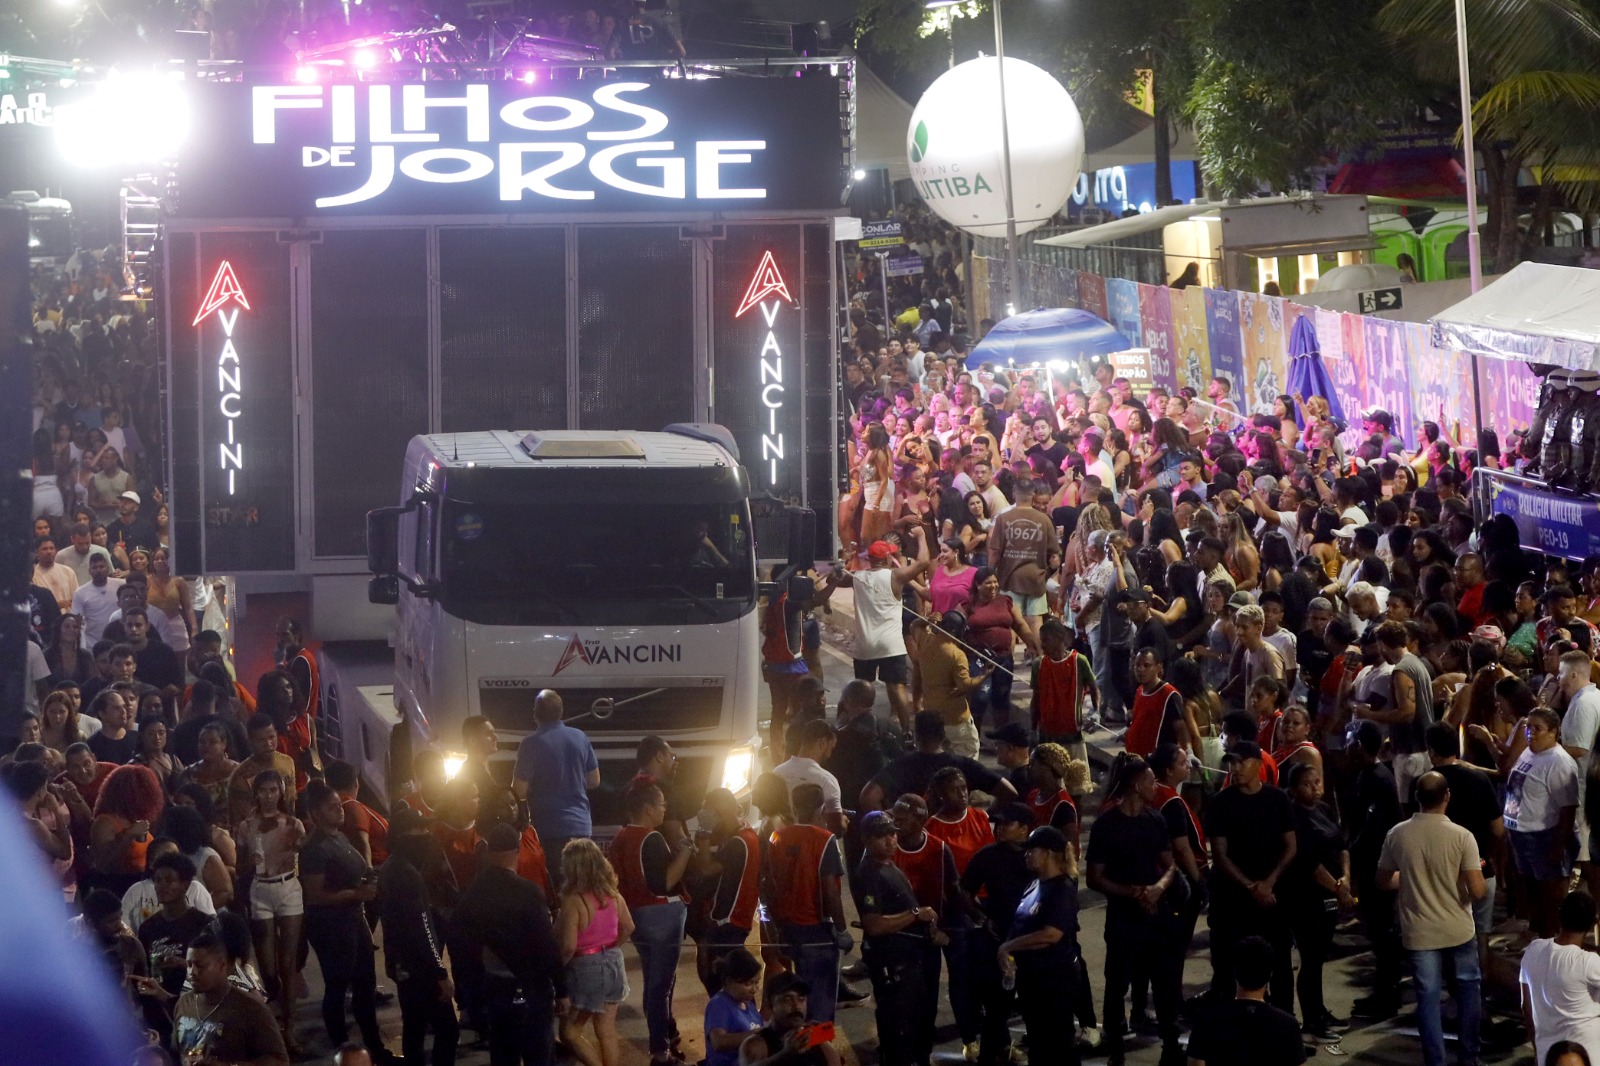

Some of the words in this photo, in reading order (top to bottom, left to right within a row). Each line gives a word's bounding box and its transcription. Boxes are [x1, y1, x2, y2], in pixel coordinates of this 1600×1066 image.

[252, 82, 669, 144] FILHOS
[302, 145, 356, 168] DE
[315, 140, 767, 208] JORGE
[1116, 354, 1145, 365] TEMOS
[1116, 367, 1147, 378] COPÃO
[1550, 499, 1584, 527] MILITAR
[1009, 527, 1037, 540] 1967
